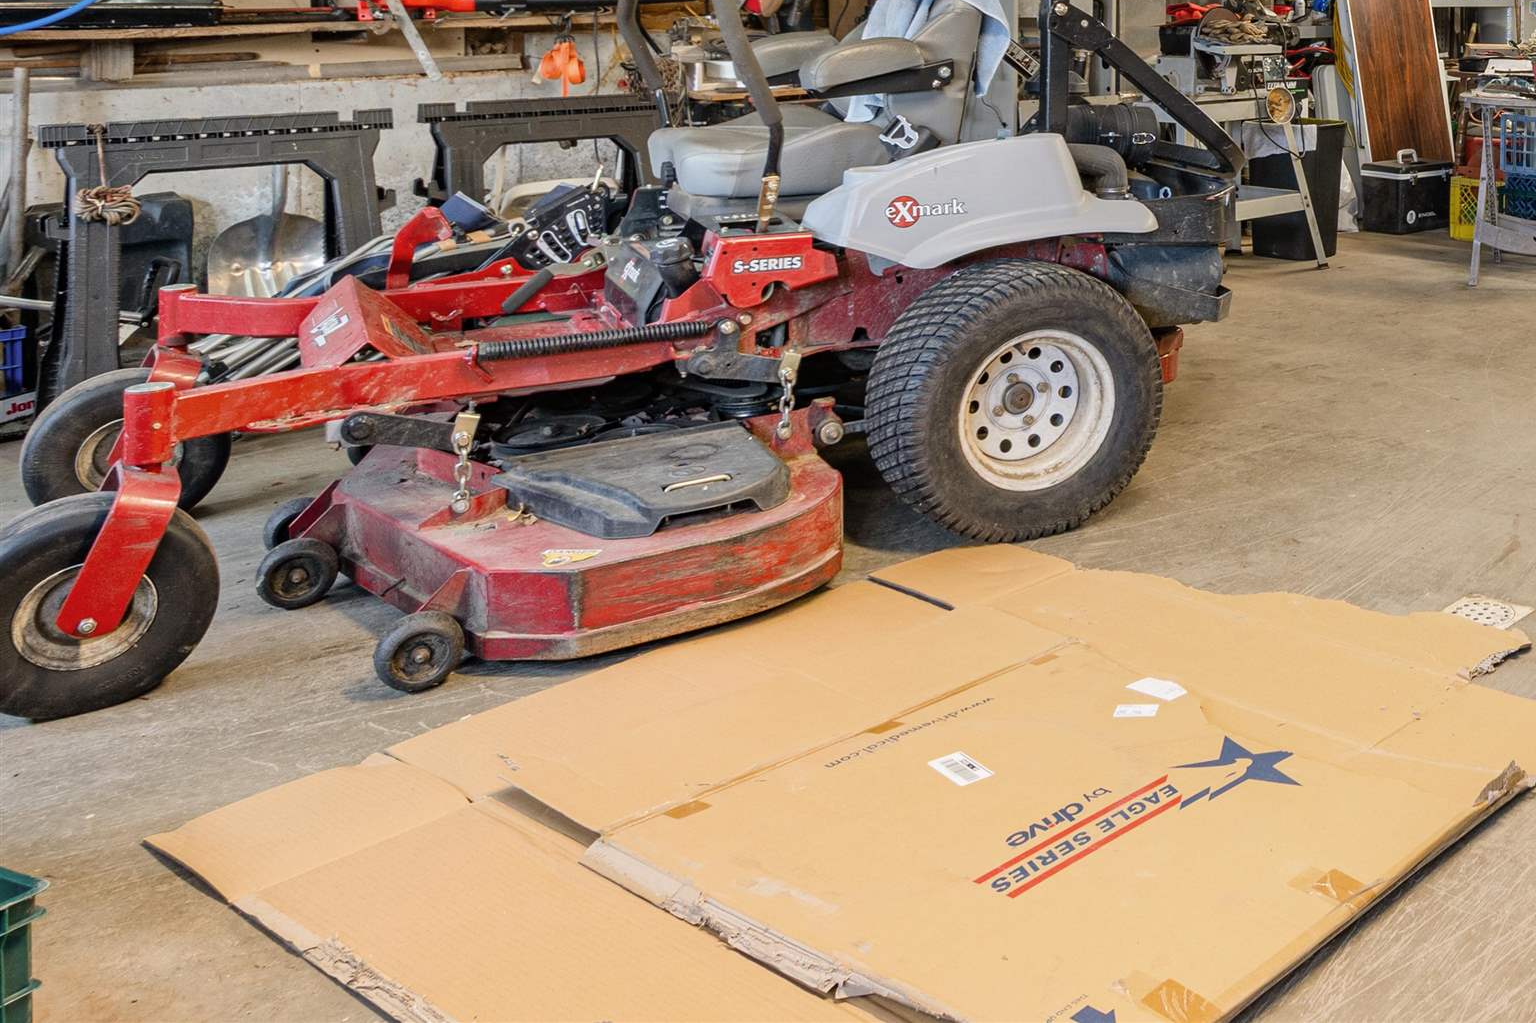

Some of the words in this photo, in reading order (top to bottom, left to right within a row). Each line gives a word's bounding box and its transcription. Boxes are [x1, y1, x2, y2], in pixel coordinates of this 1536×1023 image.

[733, 256, 803, 274] S-SERIES
[824, 697, 996, 769] www.drivemedical.com
[1082, 786, 1113, 803] by
[1095, 784, 1179, 833] EAGLE
[1005, 802, 1085, 847] drive
[990, 831, 1092, 893] SERIES
